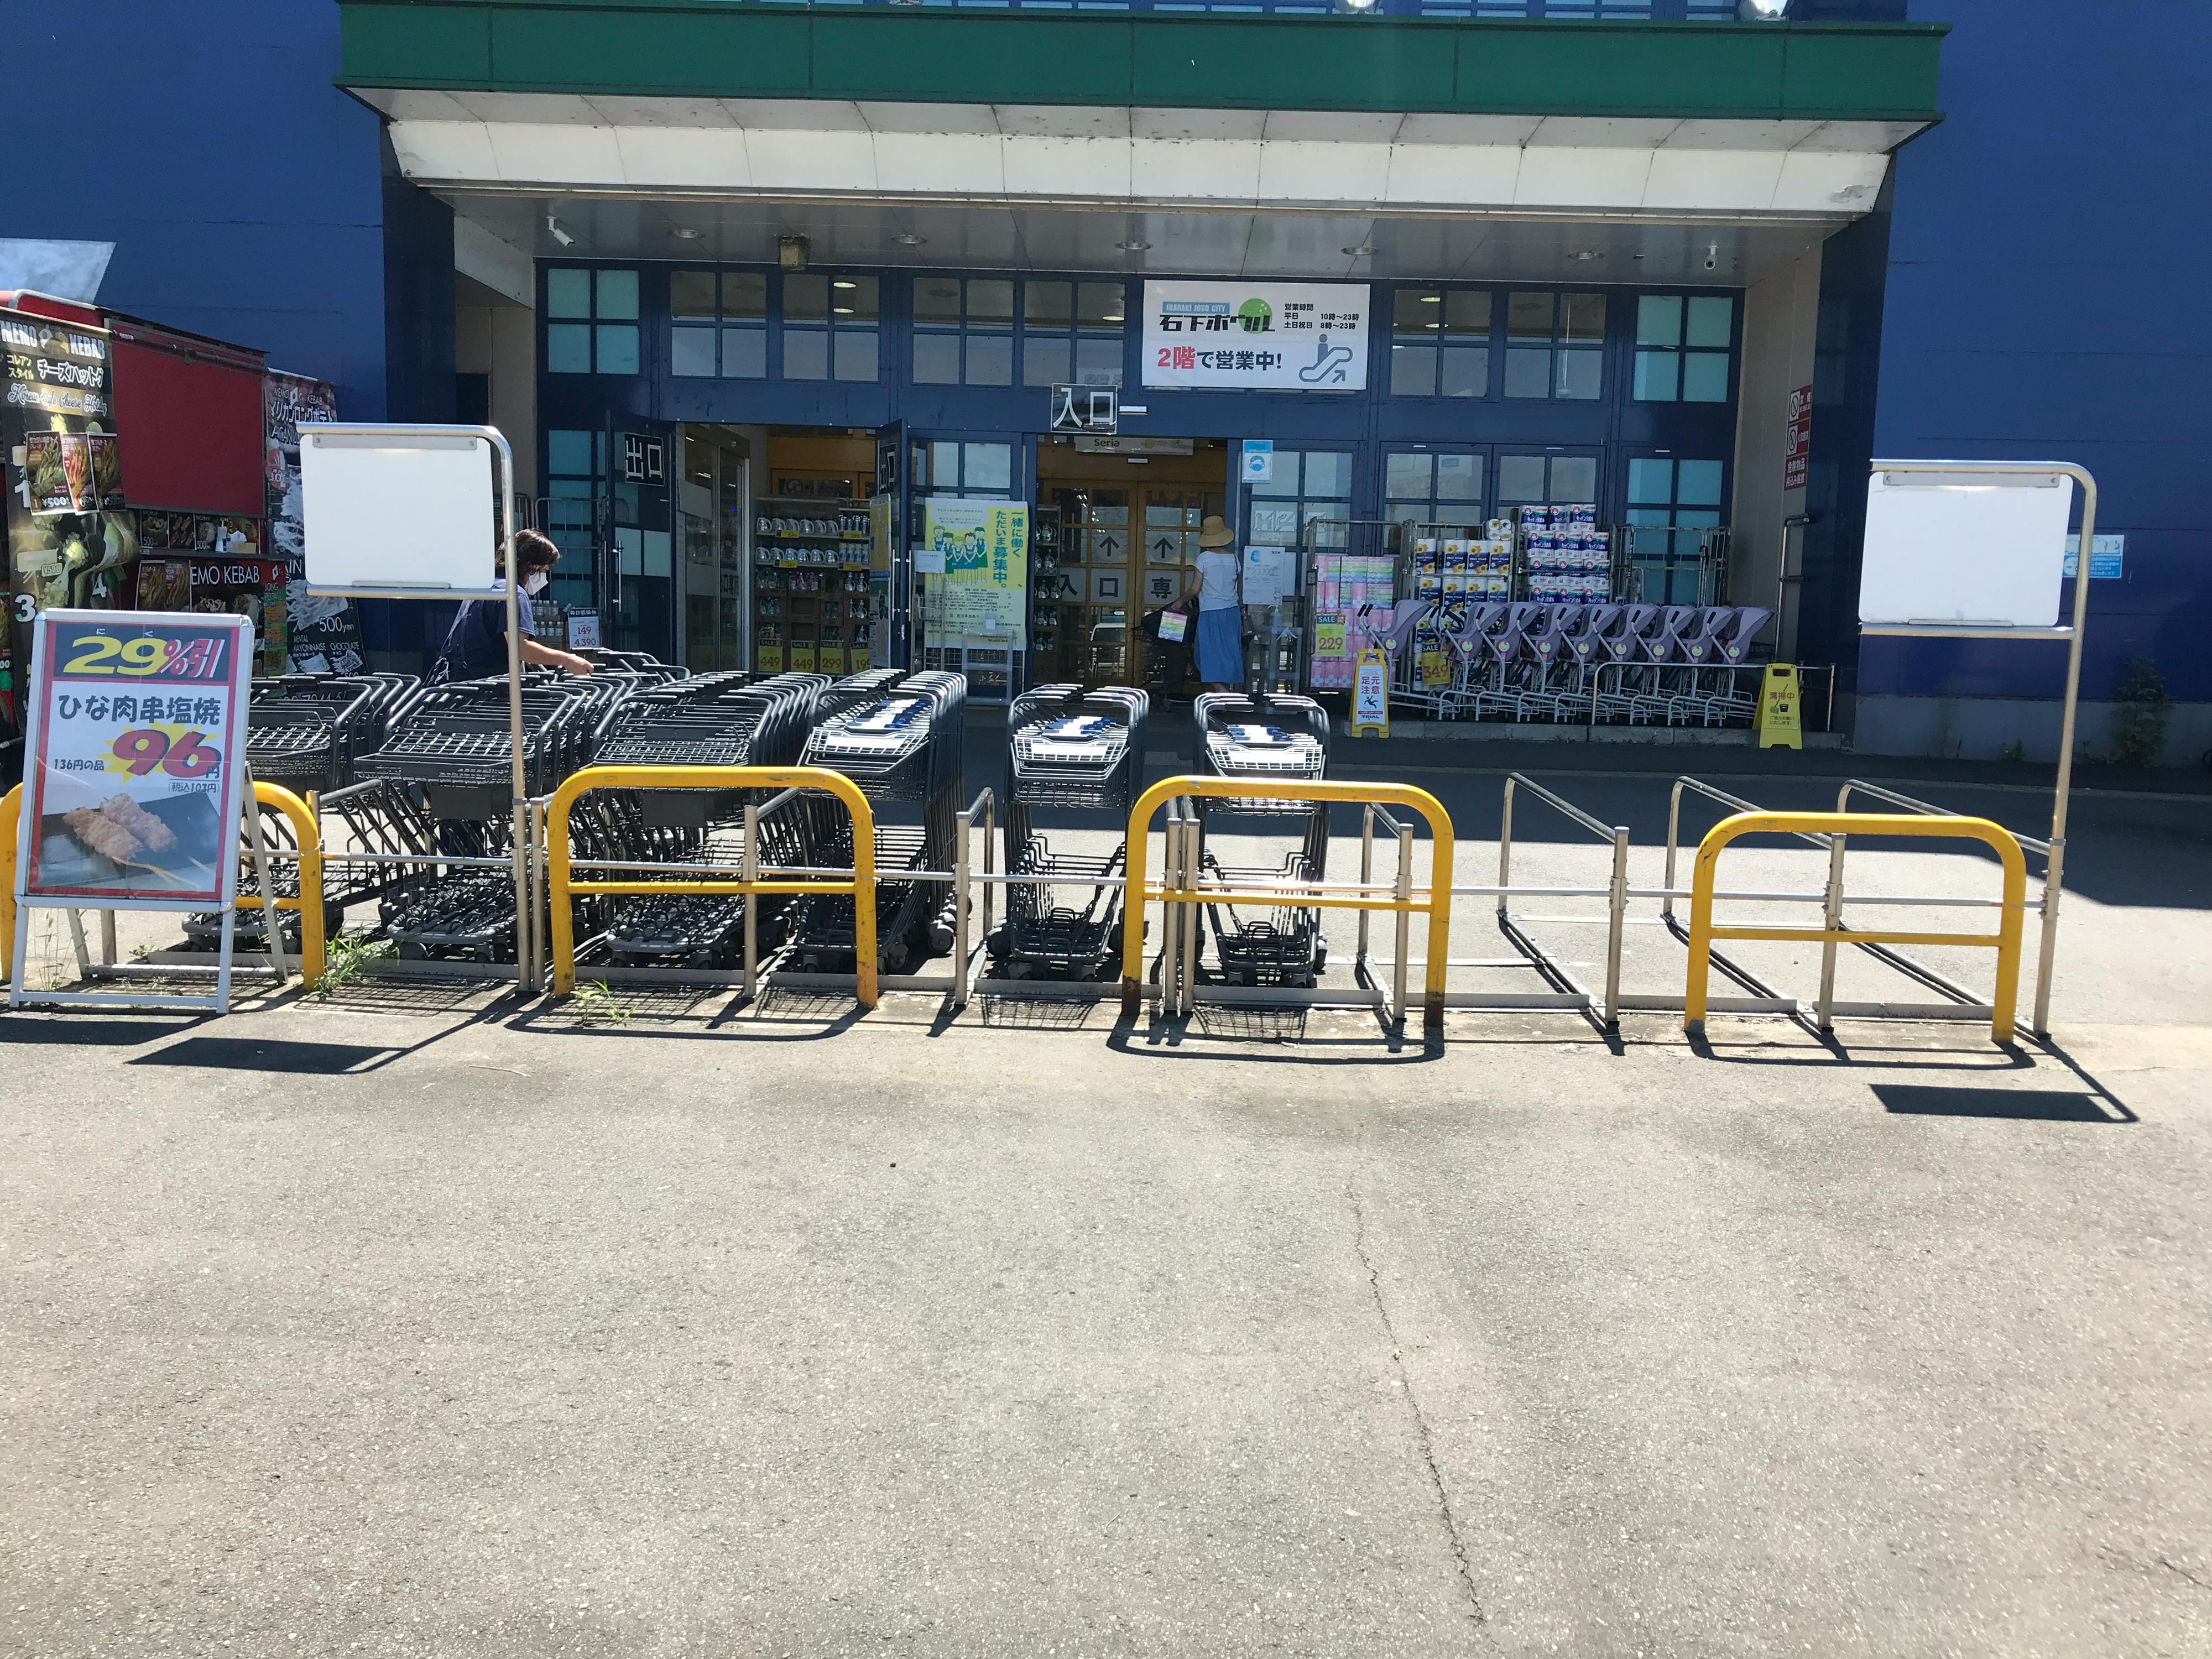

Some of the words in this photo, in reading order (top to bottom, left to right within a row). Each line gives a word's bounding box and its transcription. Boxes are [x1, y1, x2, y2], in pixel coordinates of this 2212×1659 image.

[0, 320, 38, 348] MEMO
[69, 333, 105, 359] KEBAB
[7, 354, 32, 367] コレアン
[8, 367, 34, 380] スタイル
[7, 383, 40, 405] Korean
[60, 391, 82, 409] Cheese
[1052, 387, 1114, 428] 入口
[1094, 439, 1120, 447] Seria
[625, 437, 662, 479] 出口
[993, 510, 1008, 588] ただいま募集中。
[224, 566, 259, 584] KEBAB
[14, 594, 36, 622] 3
[577, 626, 591, 634] 149
[330, 642, 359, 651] CHOCOLATE
[1319, 637, 1343, 650] 229
[761, 656, 780, 667] 449
[794, 659, 813, 669] 449
[822, 658, 842, 668] 299
[1424, 664, 1448, 679] 349
[1362, 676, 1380, 685] 足元
[1361, 686, 1380, 695] 注意
[1770, 691, 1795, 700] 清掃中
[59, 695, 221, 725] ひな肉串塩焼
[54, 759, 104, 770] 136円の品
